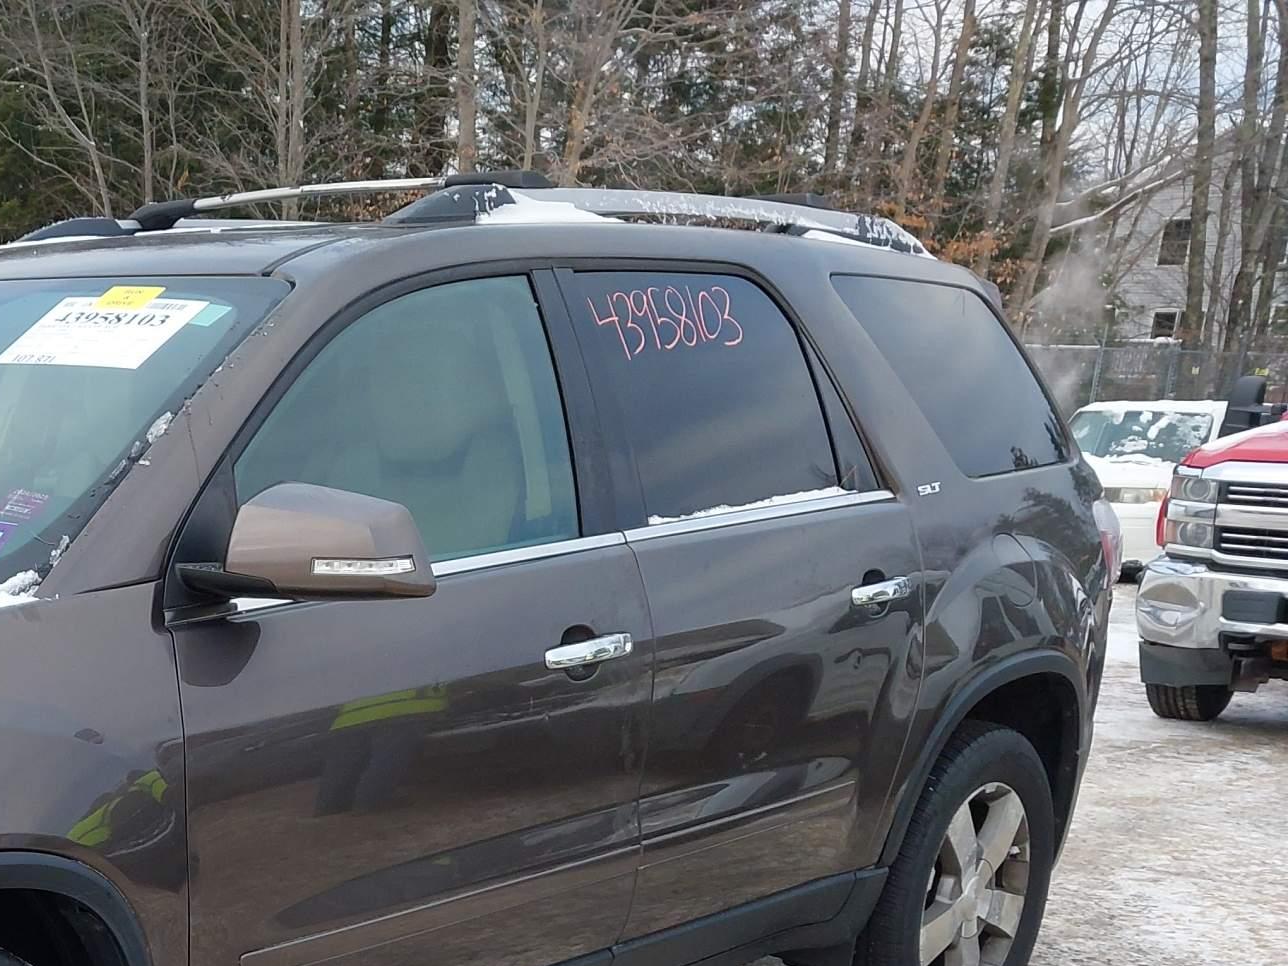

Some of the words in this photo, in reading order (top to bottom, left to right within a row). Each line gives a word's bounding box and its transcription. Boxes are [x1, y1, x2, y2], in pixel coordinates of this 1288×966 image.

[55, 311, 170, 327] 43958103
[586, 285, 744, 361] 43958103
[917, 481, 941, 496] SLT
